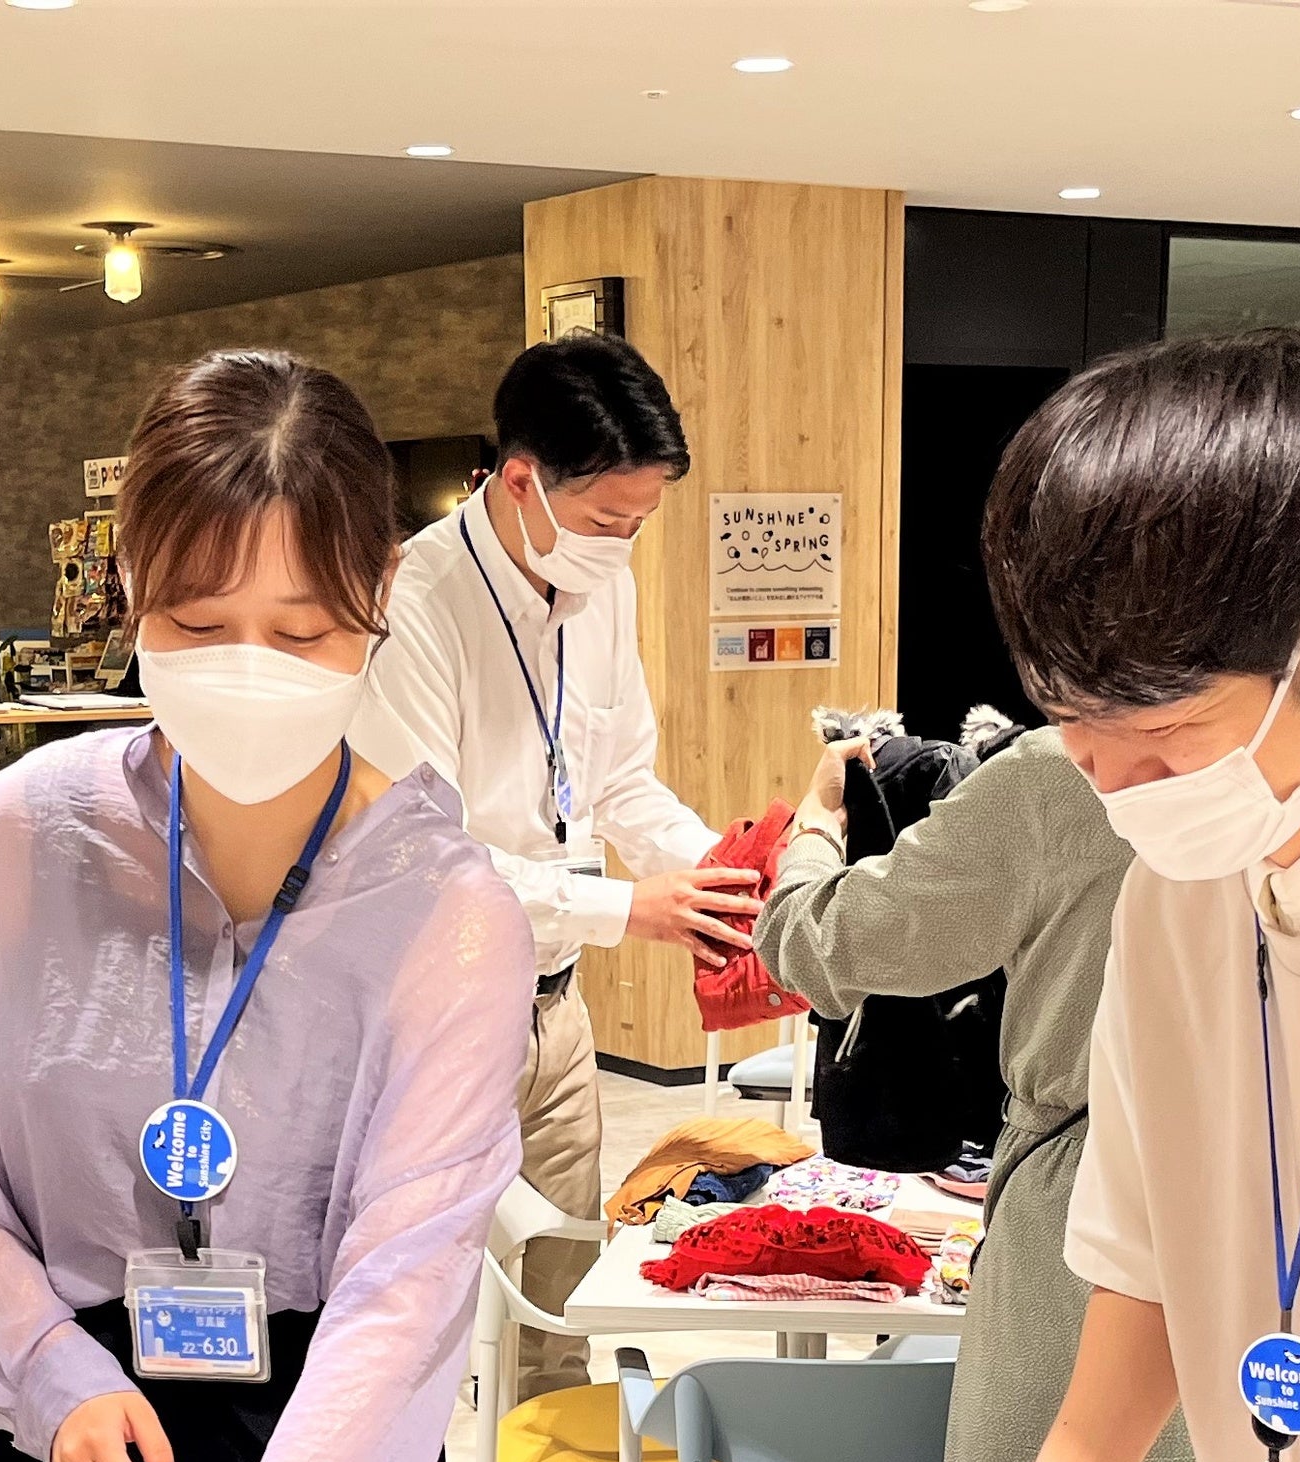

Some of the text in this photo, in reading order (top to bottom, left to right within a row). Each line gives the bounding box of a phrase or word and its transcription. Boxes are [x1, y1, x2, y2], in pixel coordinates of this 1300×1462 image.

[723, 508, 805, 526] SUNSHINE
[775, 534, 829, 552] SPRING
[166, 1111, 187, 1188] Welcome
[186, 1145, 198, 1159] to
[198, 1119, 212, 1188] Sunshine City
[1280, 1384, 1294, 1396] to
[1254, 1395, 1299, 1410] Sunshine
